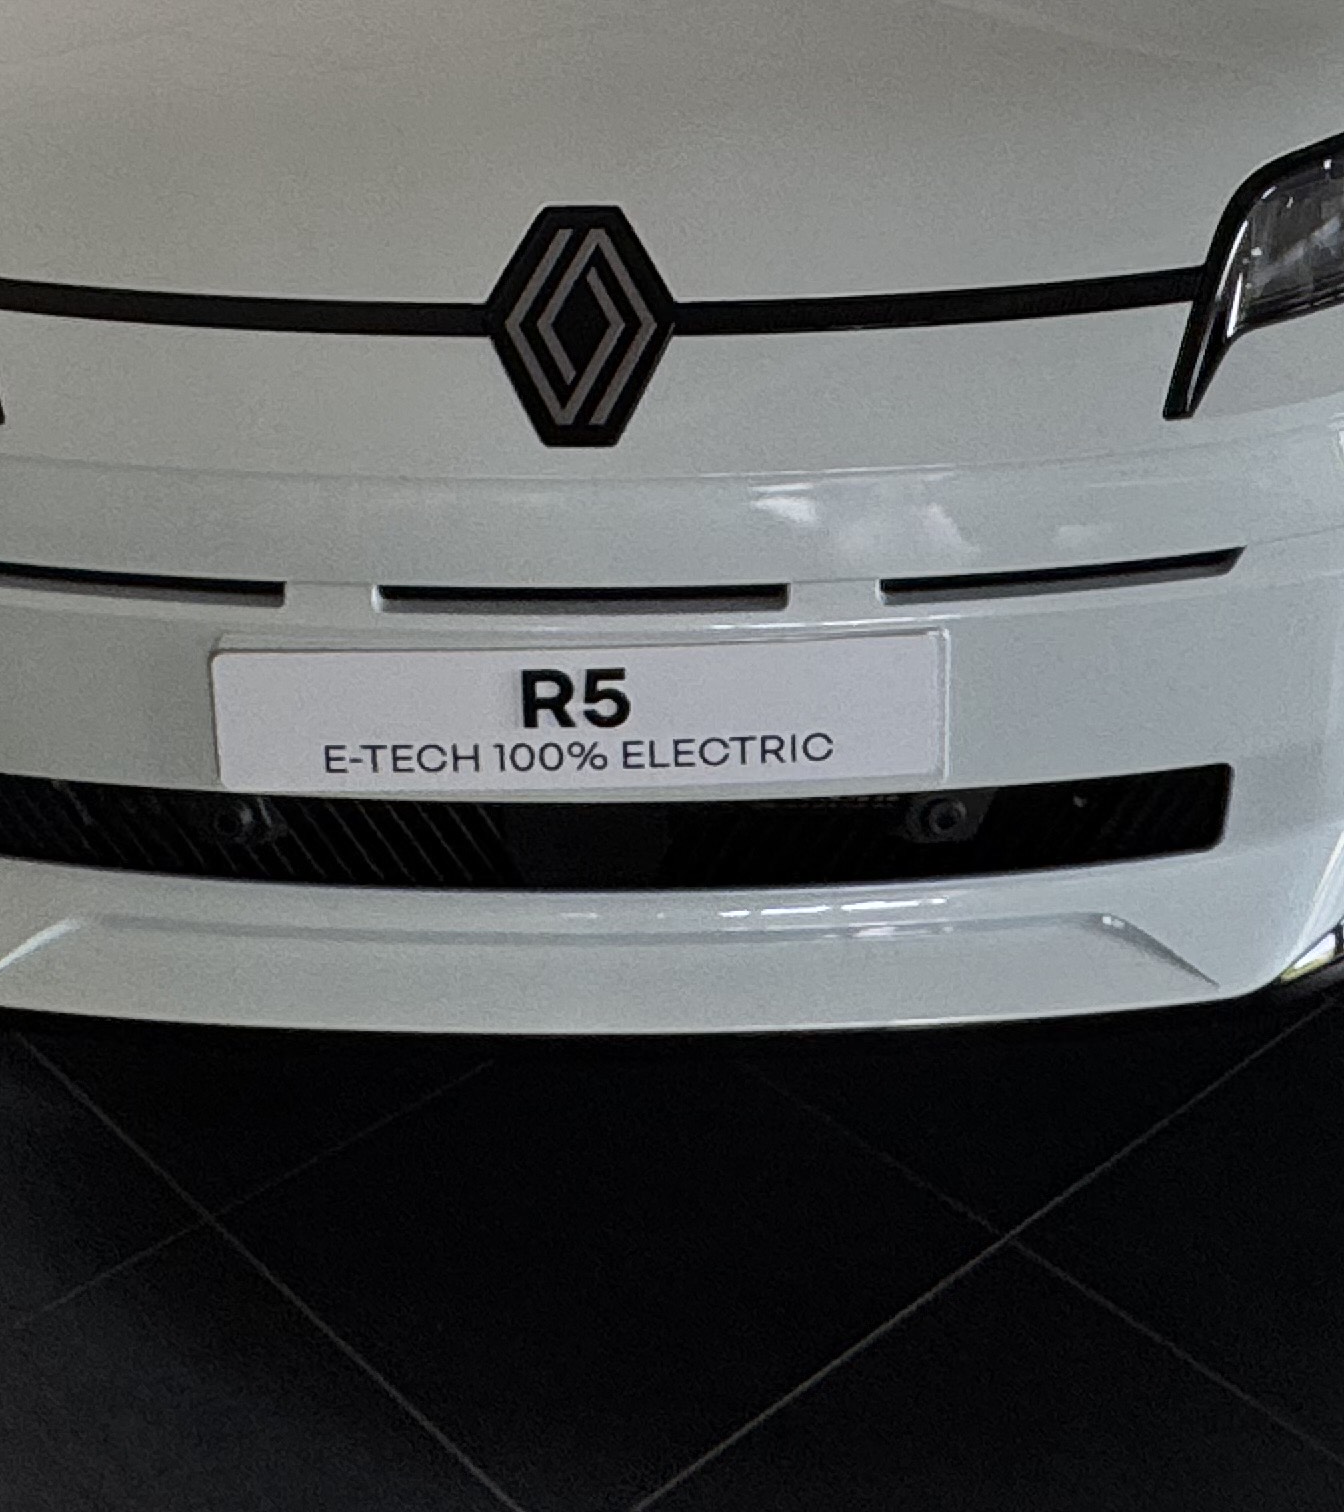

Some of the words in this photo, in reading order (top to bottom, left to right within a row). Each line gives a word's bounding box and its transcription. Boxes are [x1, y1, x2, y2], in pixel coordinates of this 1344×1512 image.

[520, 666, 632, 729] R5
[323, 743, 481, 775] E-TECH
[493, 740, 609, 773] 100%
[622, 732, 835, 770] ELECTRIC
